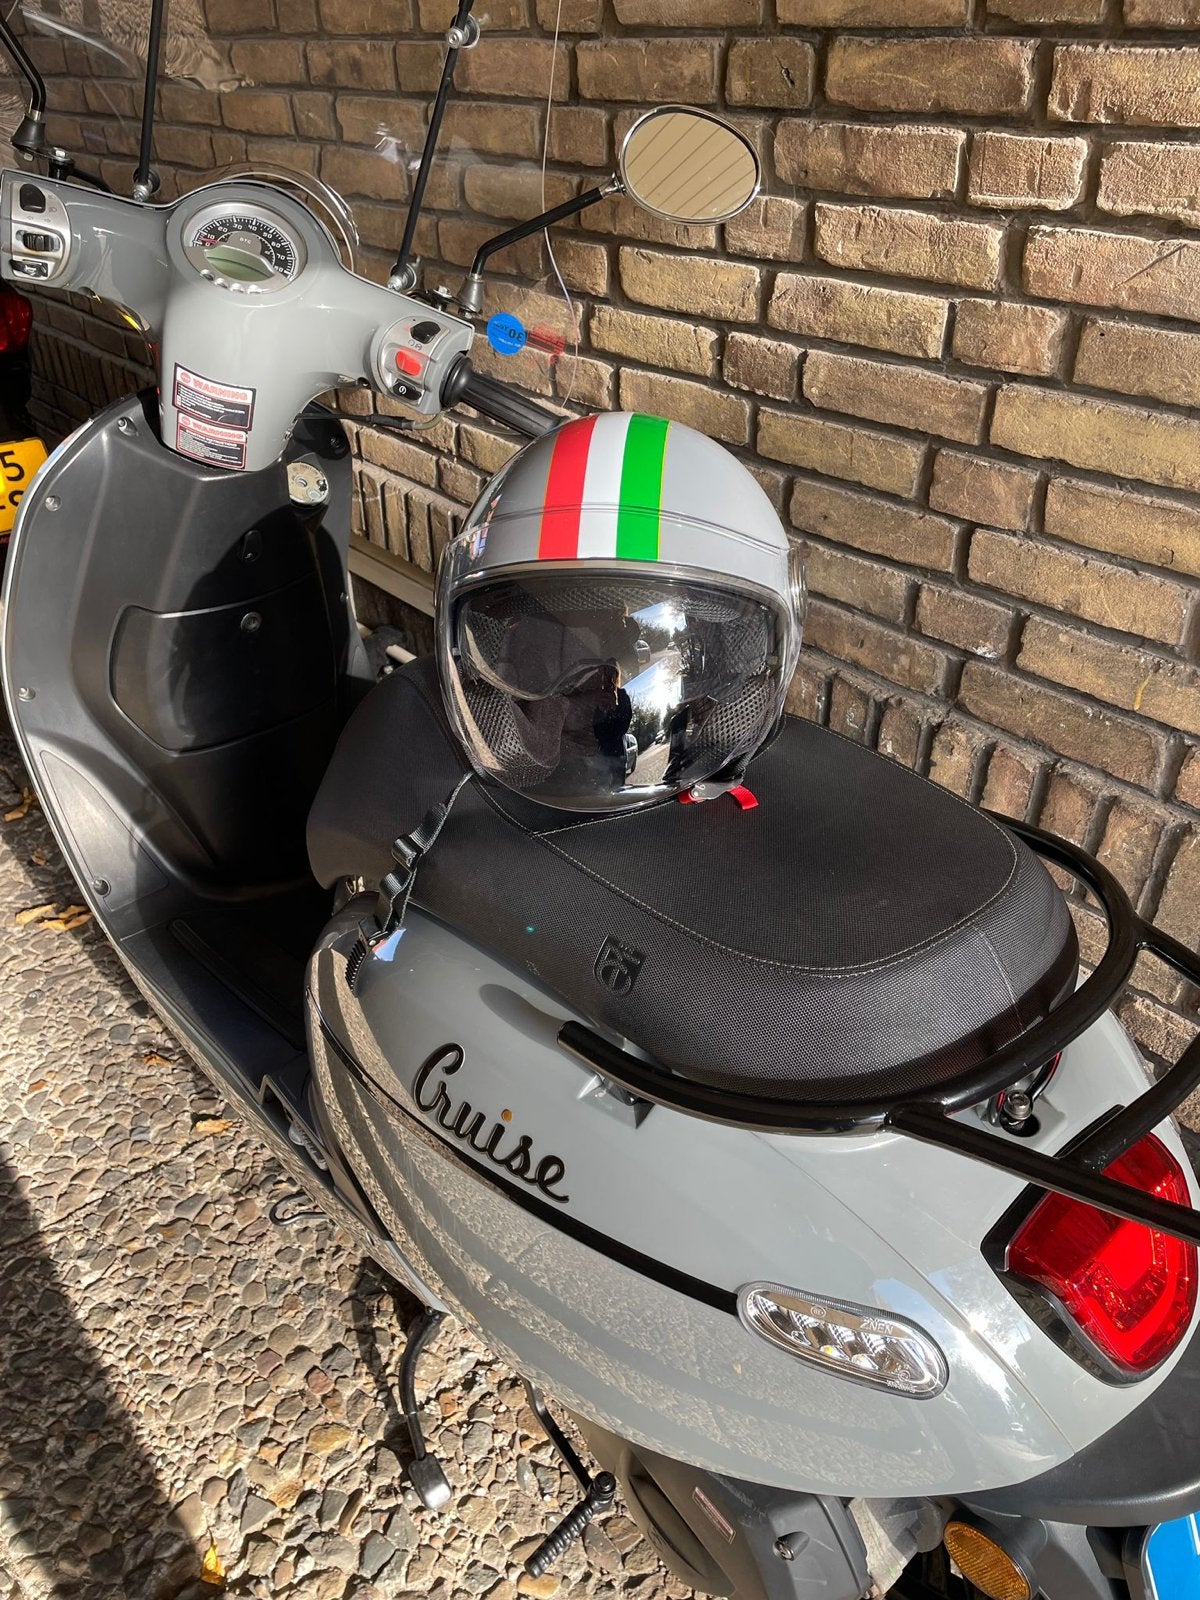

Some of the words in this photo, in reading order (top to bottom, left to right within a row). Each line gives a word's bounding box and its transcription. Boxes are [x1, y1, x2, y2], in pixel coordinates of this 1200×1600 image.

[271, 241, 281, 249] 60
[276, 253, 286, 261] 70
[274, 265, 284, 273] 80
[192, 377, 249, 401] WARNING
[192, 421, 244, 440] WARNING
[413, 1042, 570, 1204] Cruise
[859, 1318, 893, 1335] ZNEN
